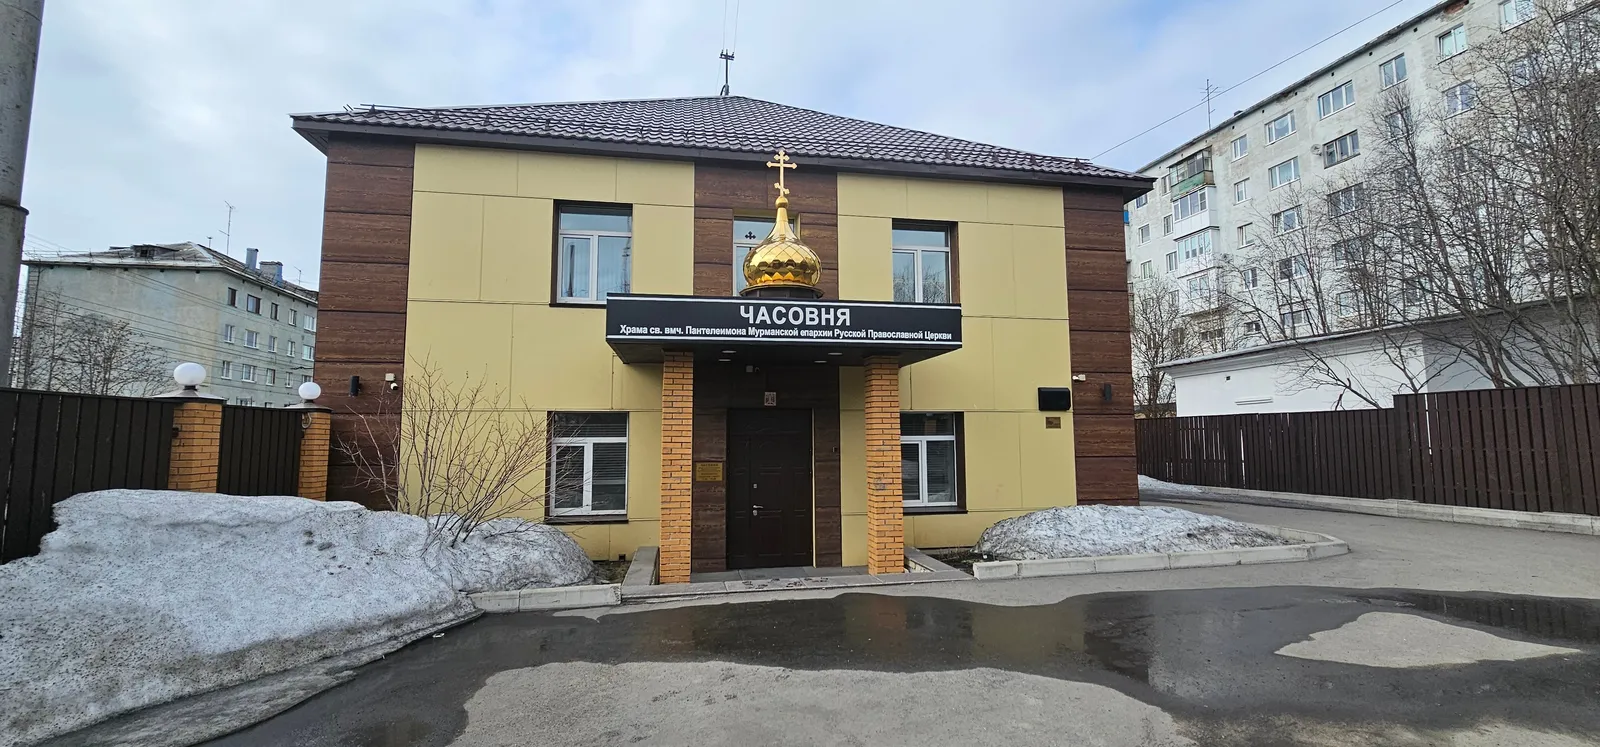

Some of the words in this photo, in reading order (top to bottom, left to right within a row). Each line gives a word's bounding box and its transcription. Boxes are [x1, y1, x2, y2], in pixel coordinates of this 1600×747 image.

[740, 306, 850, 326] ЧАСОВНЯ
[620, 325, 647, 335] Храма
[686, 326, 746, 335] Пантелеимона
[749, 327, 798, 337] Мурманской
[800, 330, 832, 338] епархии
[834, 329, 866, 339] Русской
[868, 330, 922, 339] Православной
[925, 332, 952, 340] Церкви
